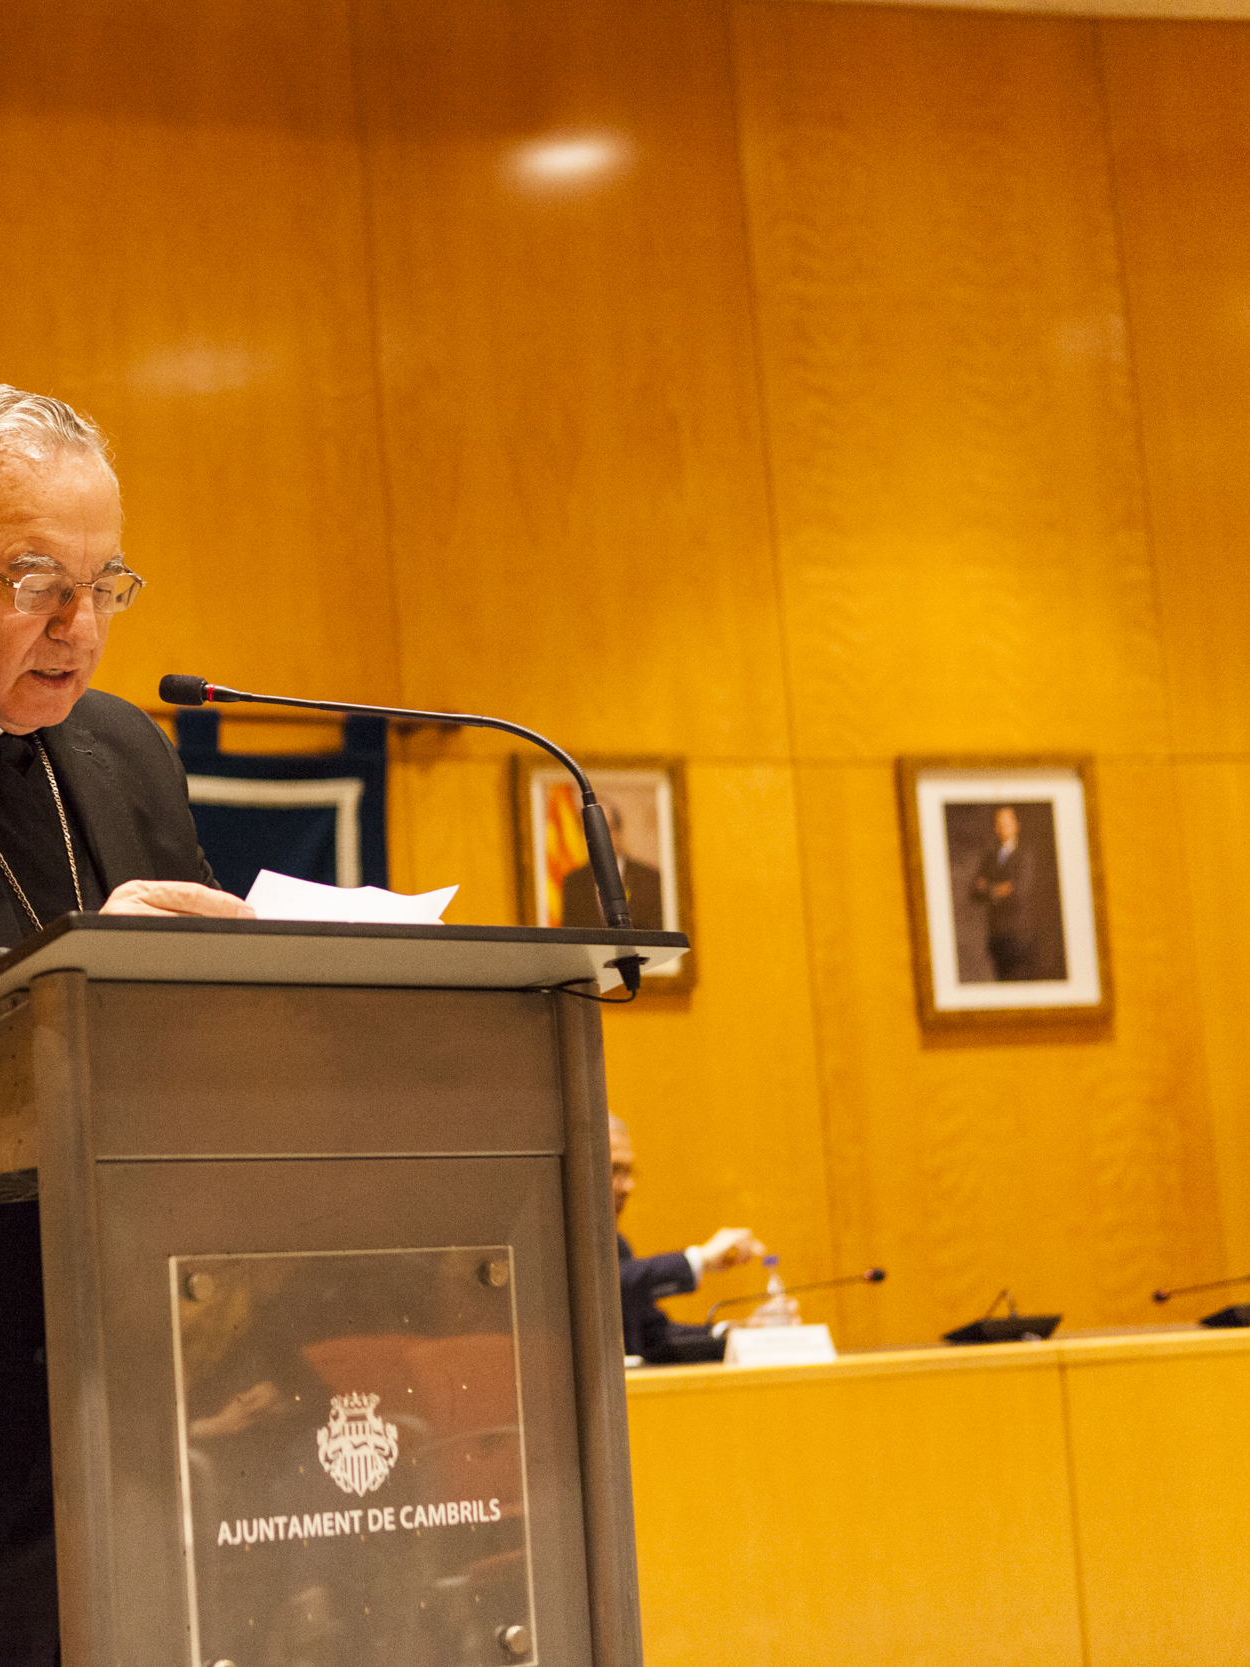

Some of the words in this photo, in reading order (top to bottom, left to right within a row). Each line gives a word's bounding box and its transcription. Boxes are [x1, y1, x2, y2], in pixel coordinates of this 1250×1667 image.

[217, 1509, 363, 1546] AJUNTAMENT
[367, 1507, 395, 1532] DE
[399, 1498, 501, 1529] CAMBRILS
